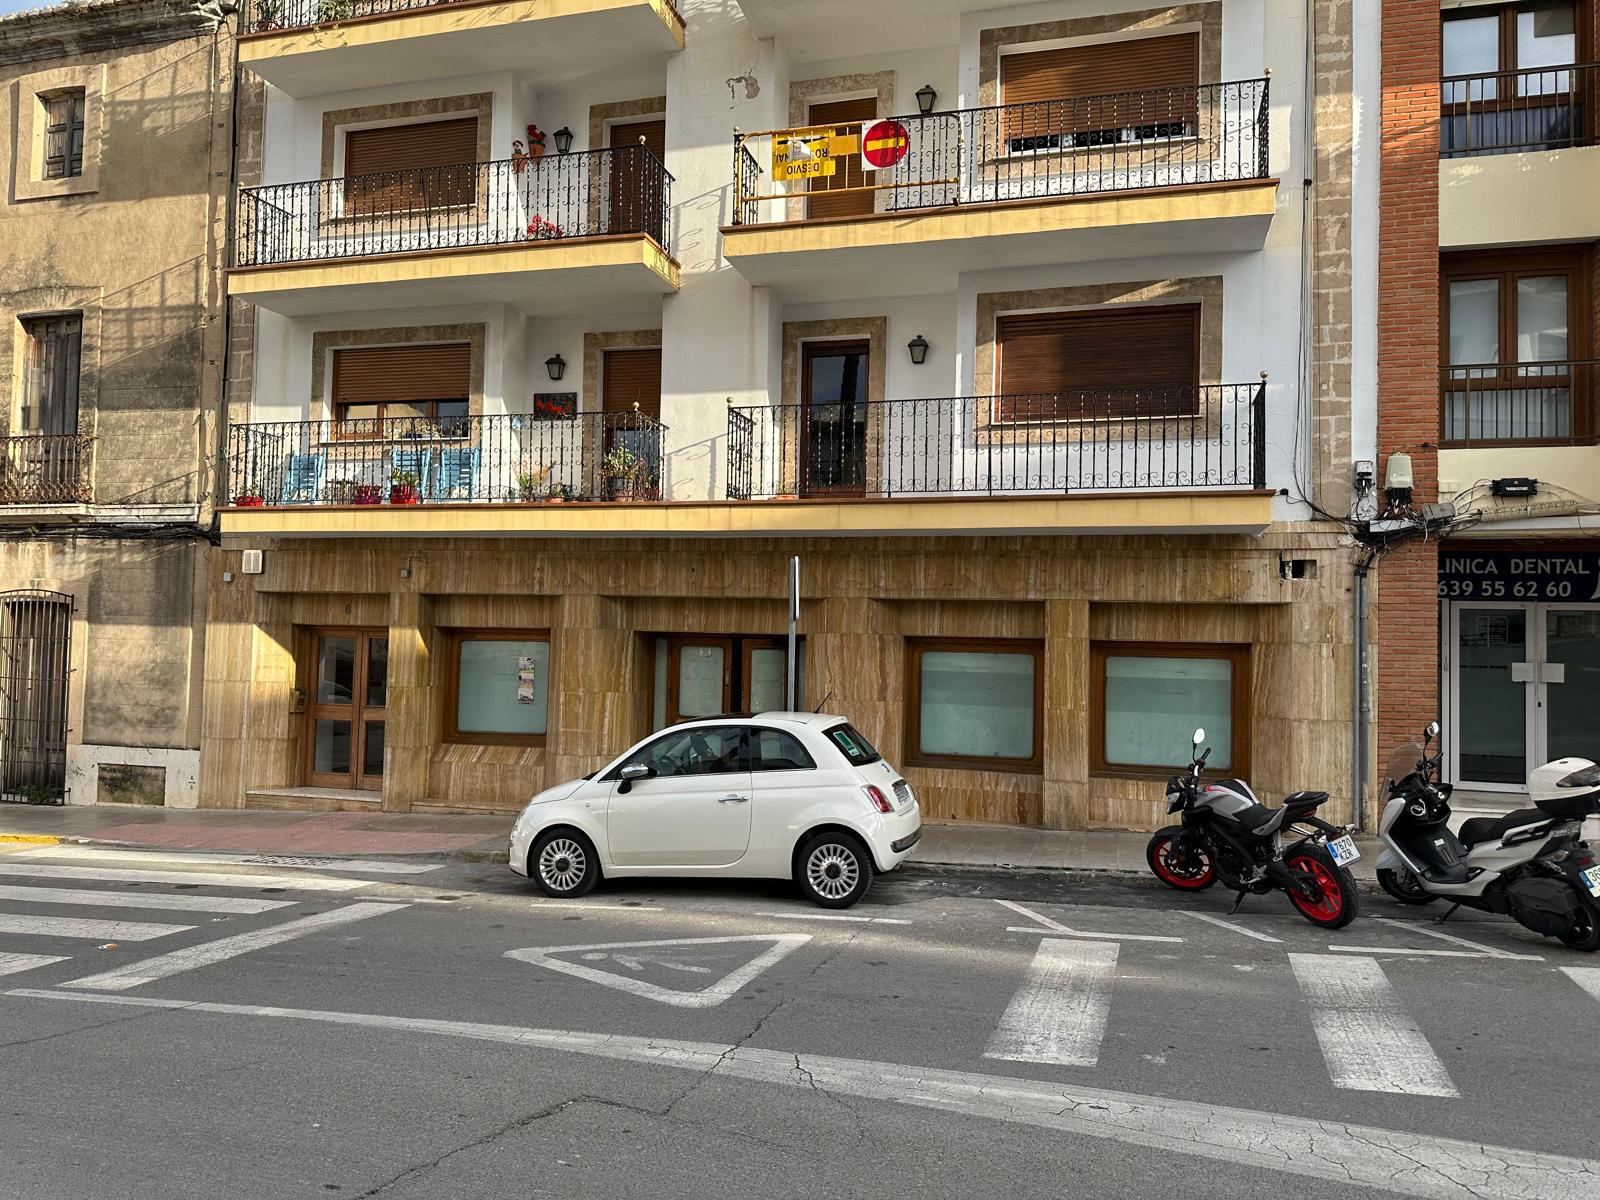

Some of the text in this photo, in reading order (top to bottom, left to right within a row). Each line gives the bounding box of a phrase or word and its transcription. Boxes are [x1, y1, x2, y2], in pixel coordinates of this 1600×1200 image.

[1510, 558, 1590, 574] DENTAL
[1437, 580, 1572, 597] 639 55 62 60
[1334, 838, 1352, 851] 7670
